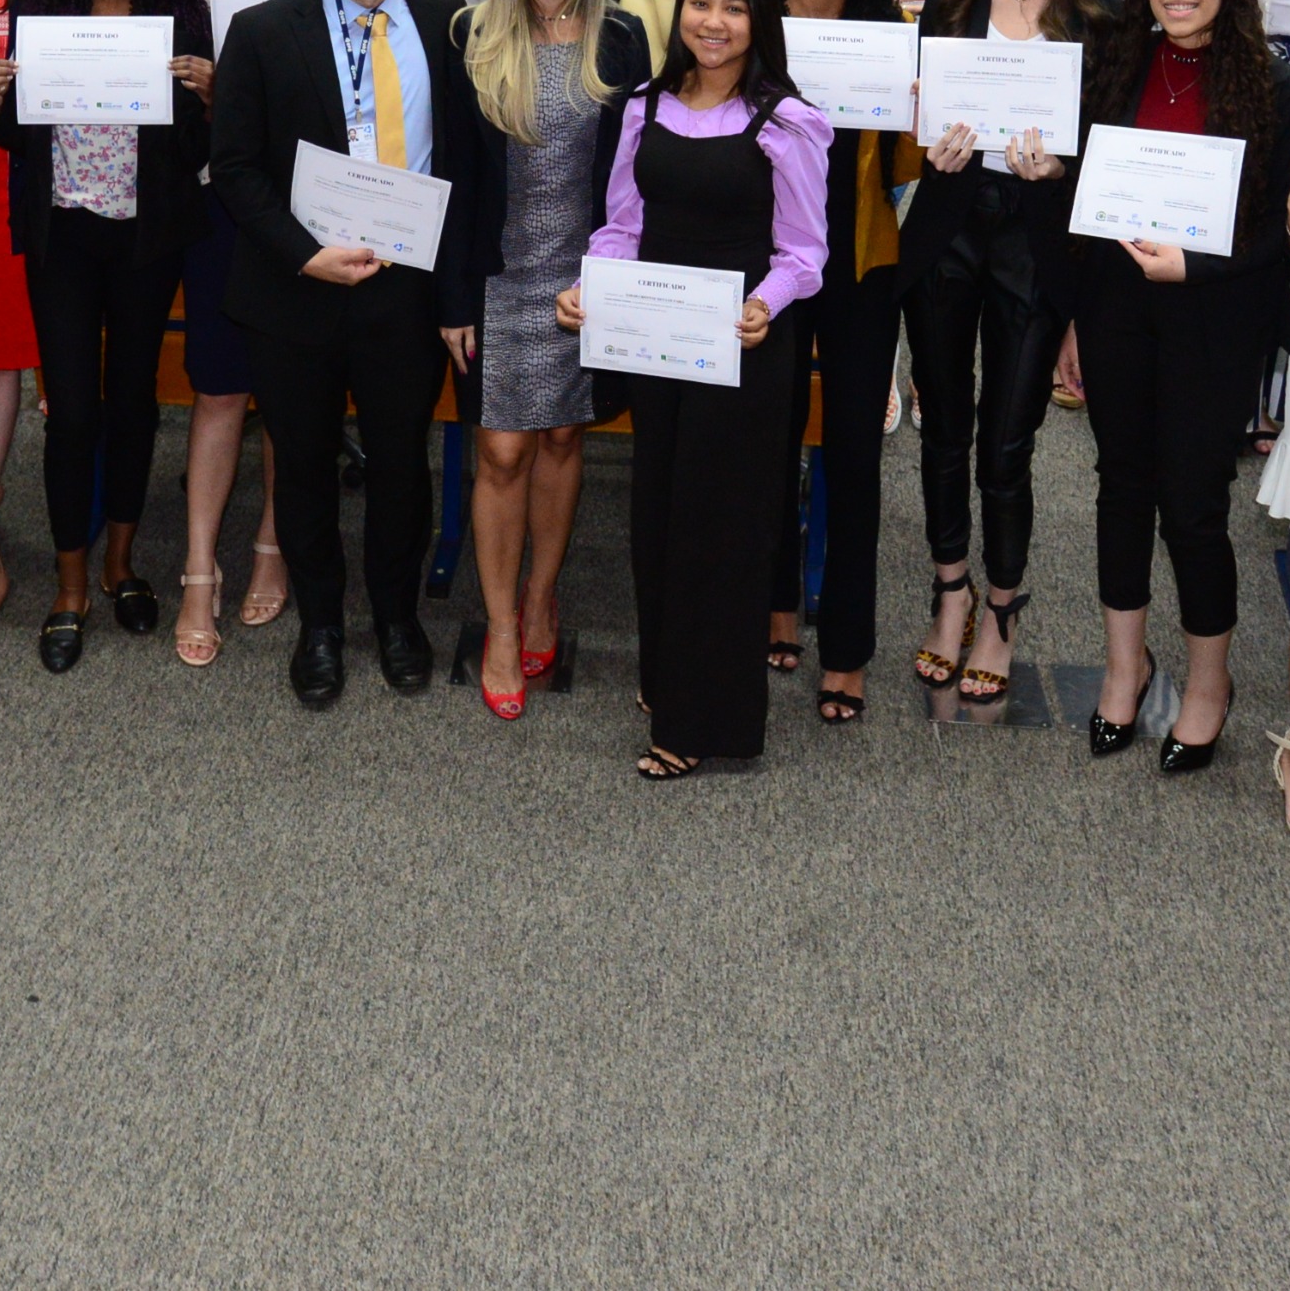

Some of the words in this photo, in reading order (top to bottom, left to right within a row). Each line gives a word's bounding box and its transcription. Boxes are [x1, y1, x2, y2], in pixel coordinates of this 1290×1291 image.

[818, 35, 864, 44] CERTIFICADO
[977, 55, 1025, 64] CERTIFICADO
[1140, 146, 1186, 157] CERTIFICADO
[347, 171, 394, 187] CERTIFICADO
[637, 278, 686, 291] CERTIFICADO
